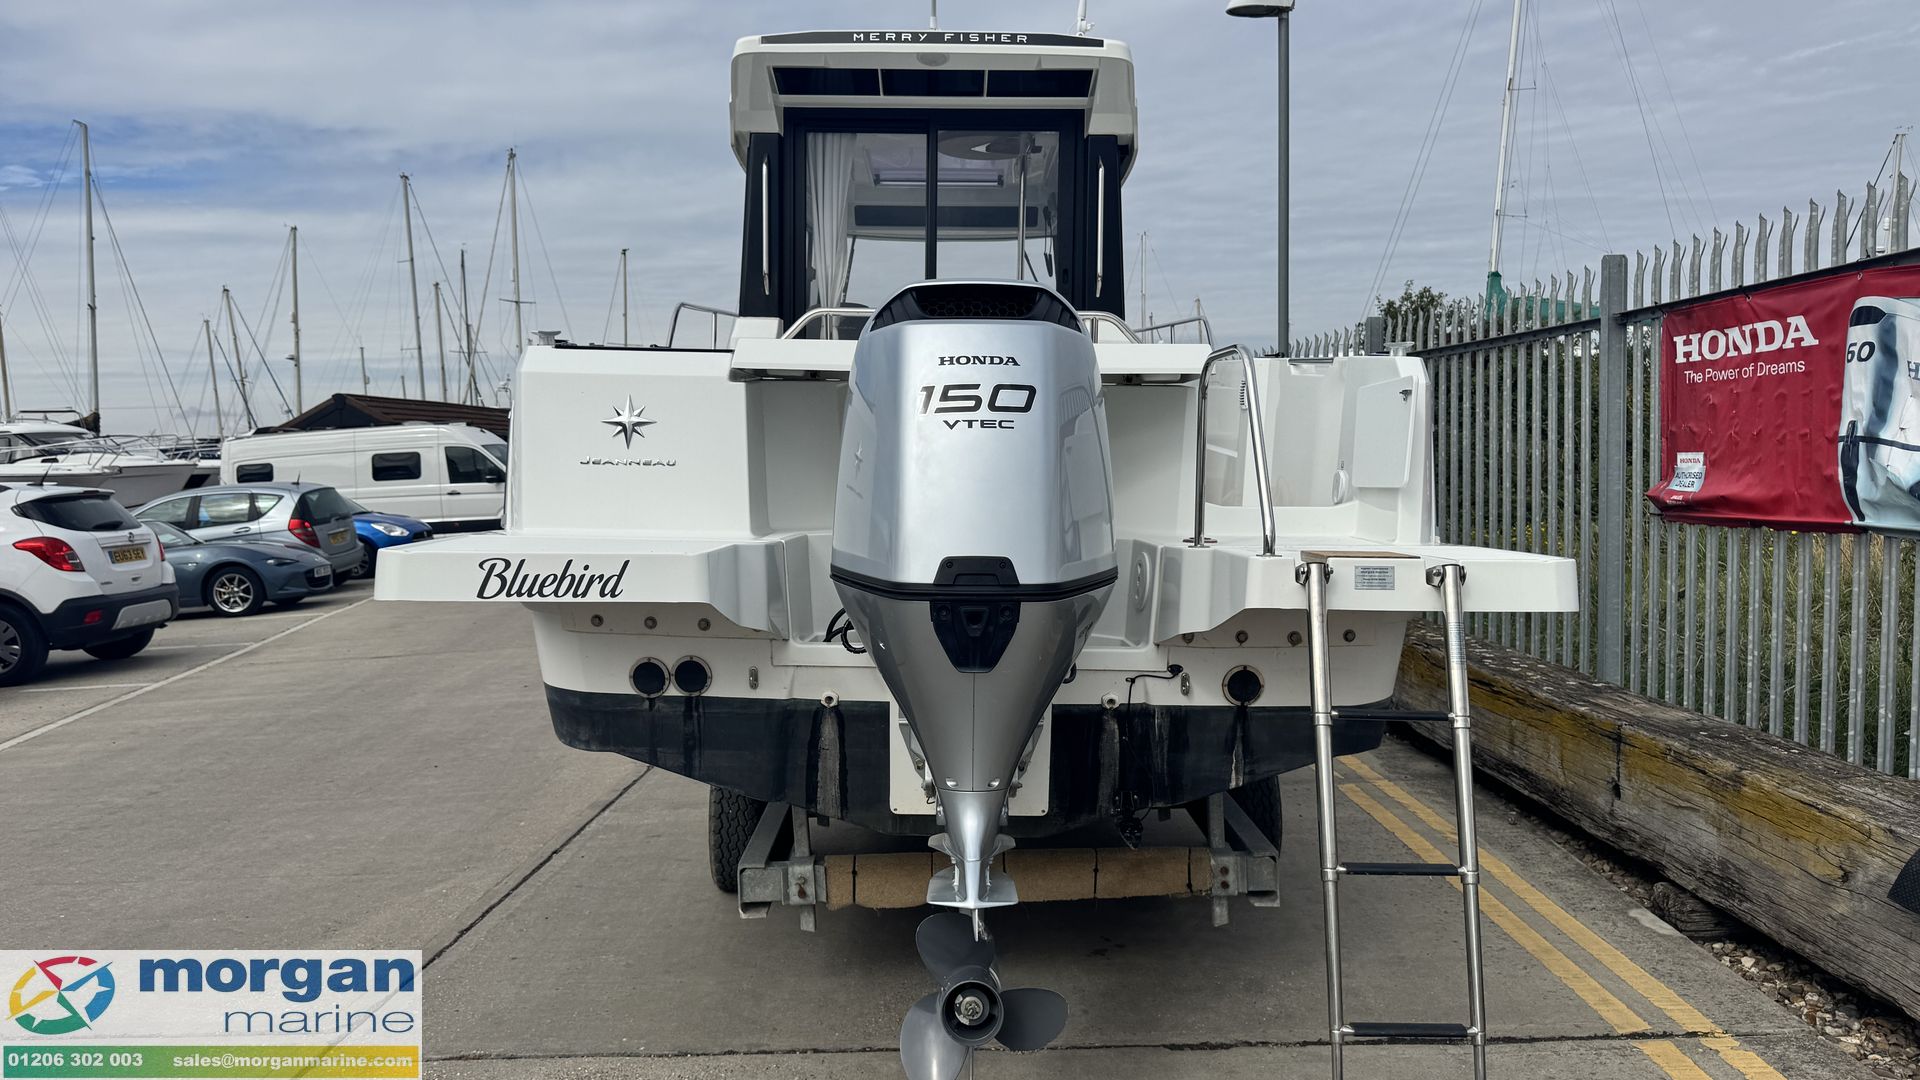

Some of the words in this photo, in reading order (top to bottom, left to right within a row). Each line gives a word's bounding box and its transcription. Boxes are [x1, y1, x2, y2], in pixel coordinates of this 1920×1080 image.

[853, 32, 928, 43] MERRY
[944, 33, 1028, 44] FISHER
[1673, 314, 1819, 364] HONDA
[938, 355, 1021, 367] HONDA
[1684, 370, 1703, 384] The
[1705, 367, 1740, 382] Power
[1741, 363, 1754, 378] of
[1757, 360, 1806, 377] Dreams
[919, 383, 1037, 415] 150
[943, 419, 1015, 430] VTEC
[579, 455, 677, 467] JEANNEAU
[1675, 471, 1702, 479] AUTHORISED
[476, 557, 631, 600] Bluebird
